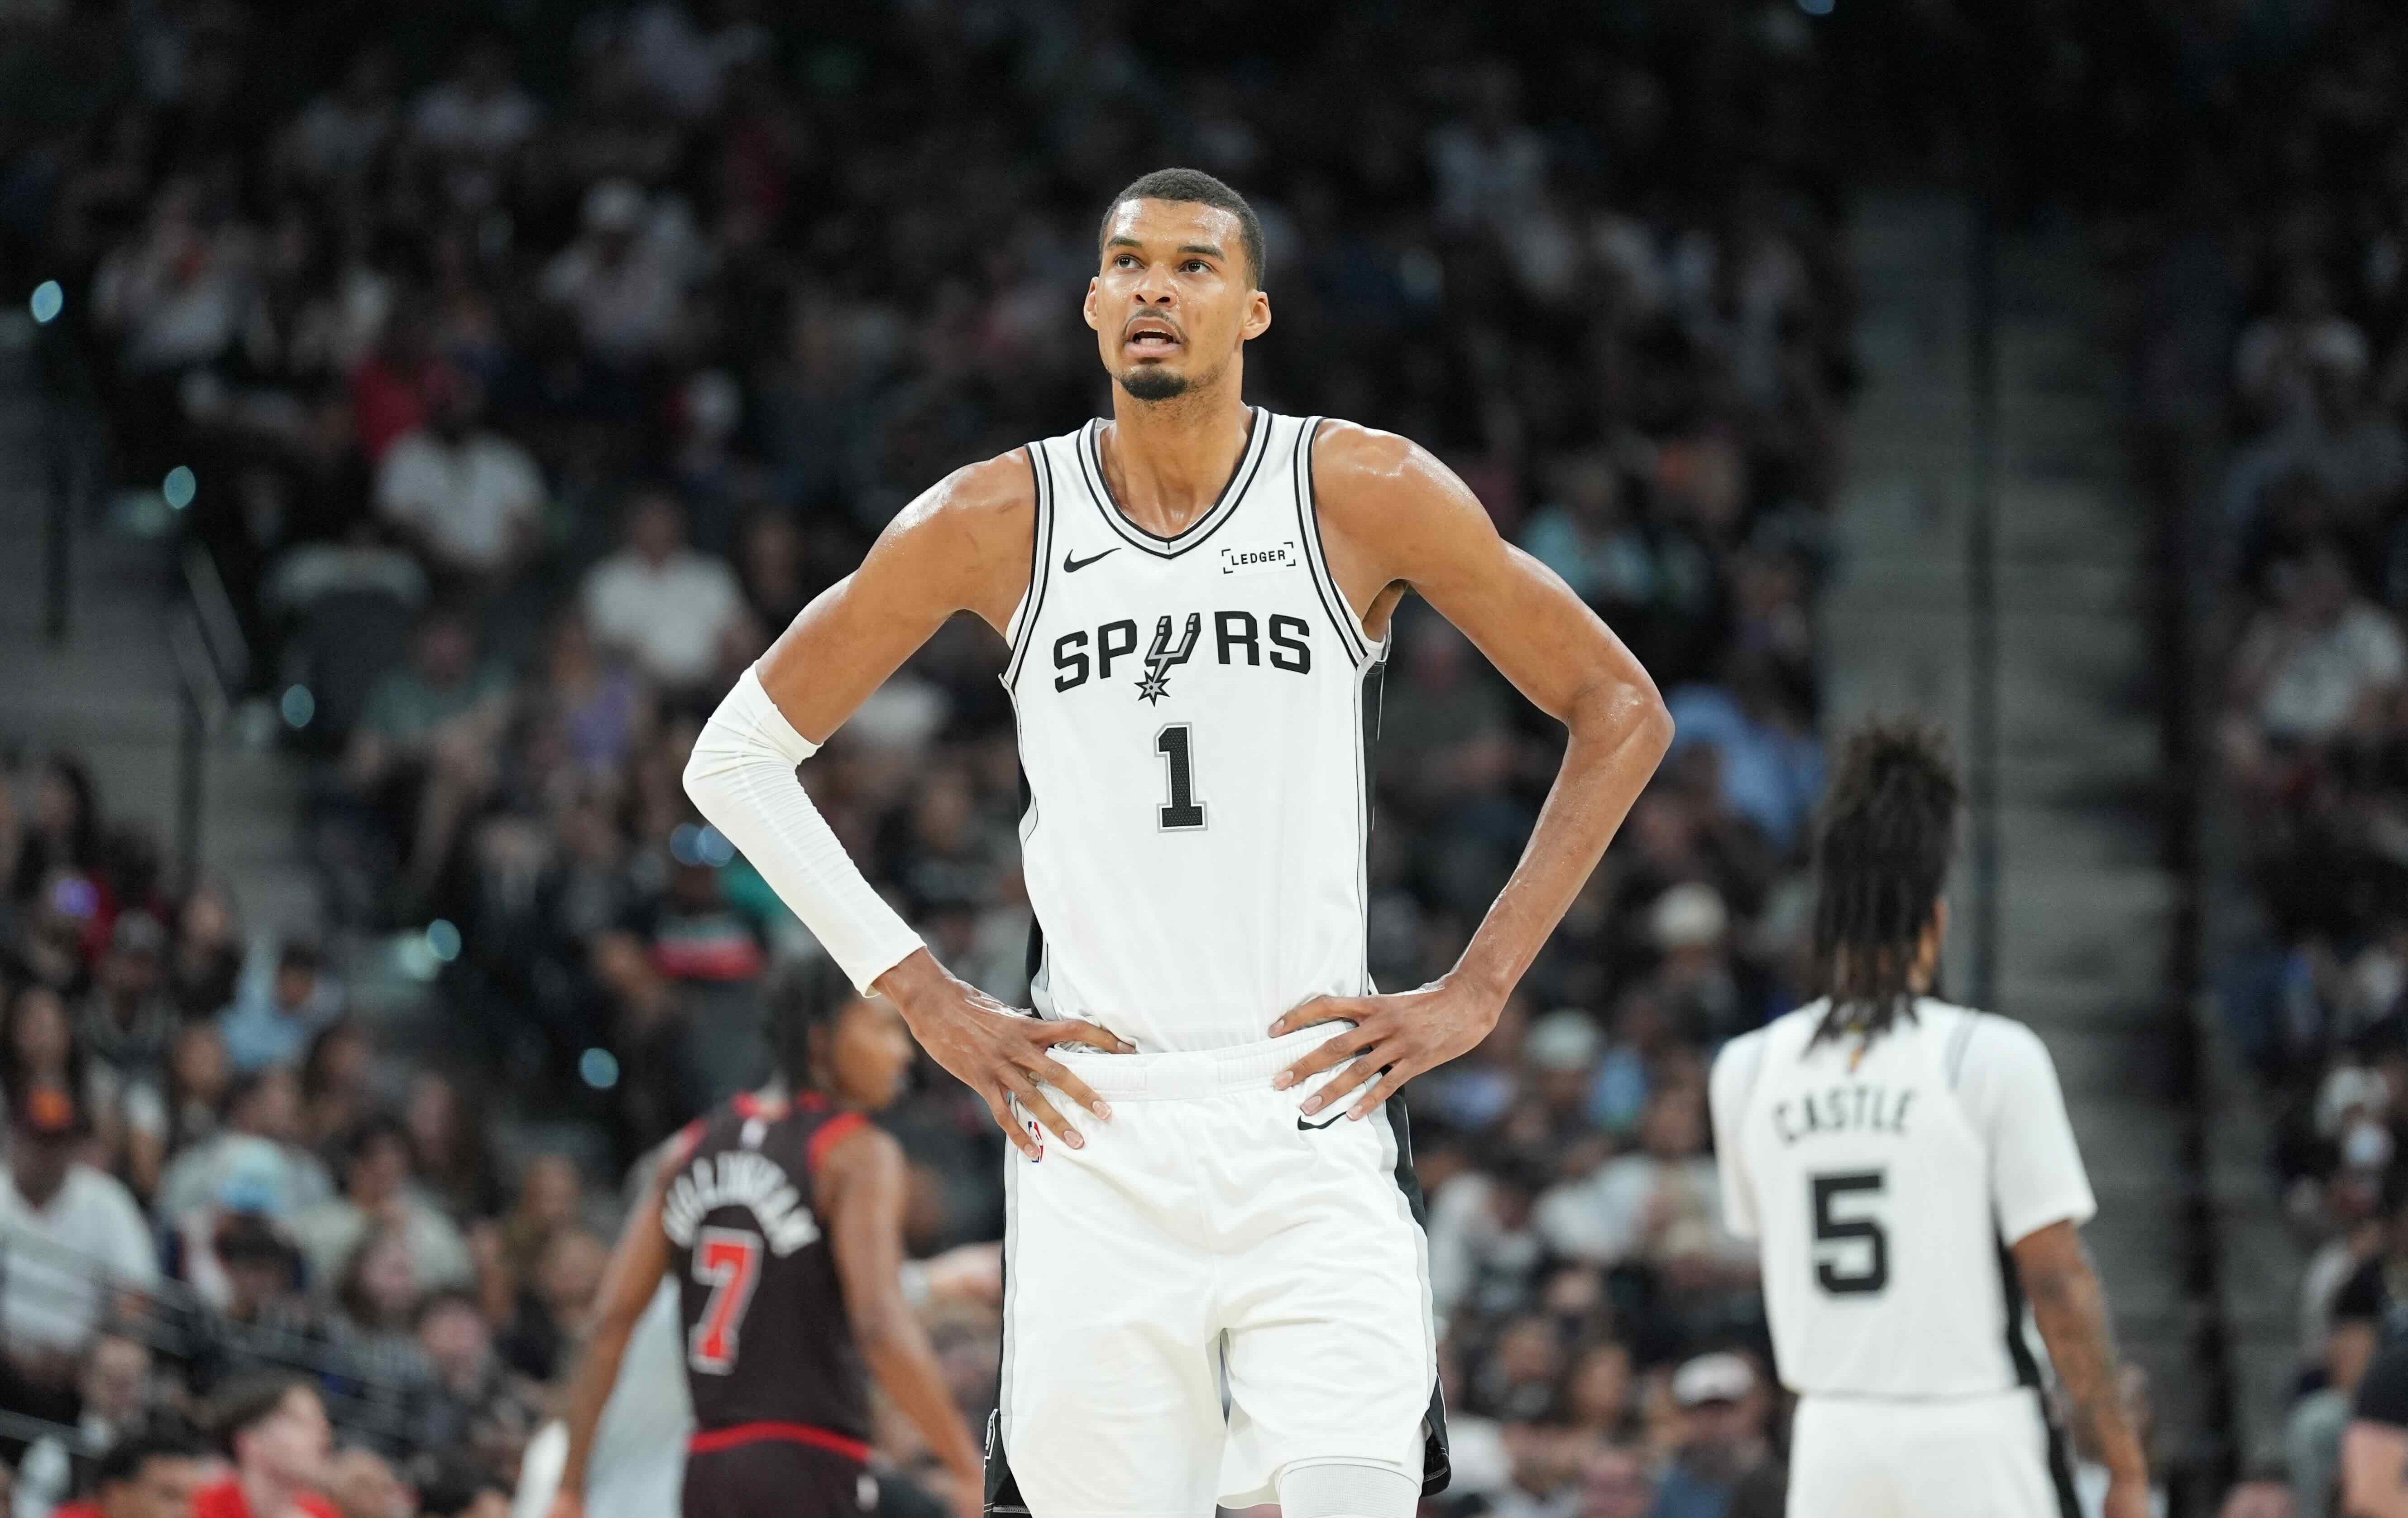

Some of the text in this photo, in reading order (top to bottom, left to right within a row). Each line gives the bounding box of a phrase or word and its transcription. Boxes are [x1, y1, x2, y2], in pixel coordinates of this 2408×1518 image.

[1231, 549, 1286, 566] LEDGER
[1053, 610, 1311, 707] SPURS
[1154, 721, 1208, 833] 1
[1774, 1087, 1917, 1144] CASTLE
[1810, 1171, 1887, 1294] 5
[689, 1225, 764, 1375] 7
